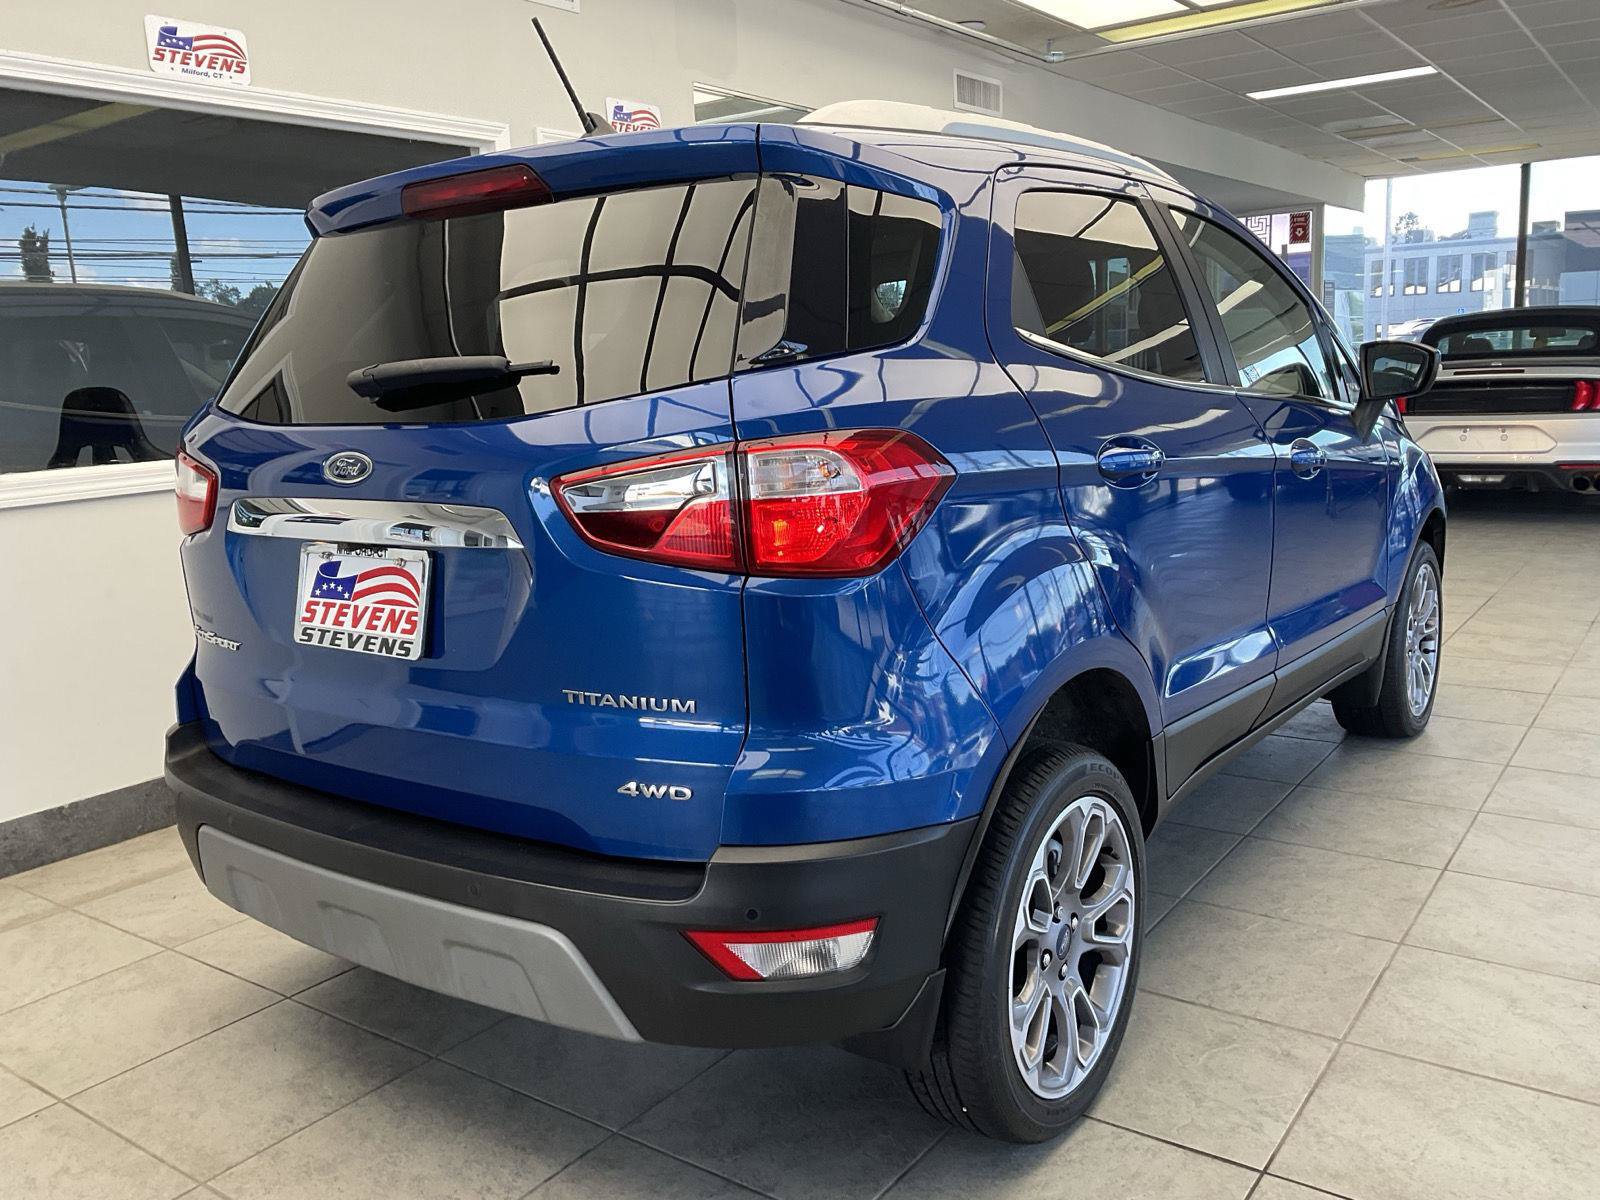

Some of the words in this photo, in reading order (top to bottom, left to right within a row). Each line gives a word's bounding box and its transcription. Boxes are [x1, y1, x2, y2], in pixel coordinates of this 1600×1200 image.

[152, 47, 247, 74] STEVENS
[611, 121, 656, 133] STEV
[333, 458, 361, 476] Ford
[301, 600, 419, 636] STEVENS
[299, 626, 414, 658] STEVENS
[561, 689, 697, 714] TITANIUM
[616, 781, 693, 801] 4WD
